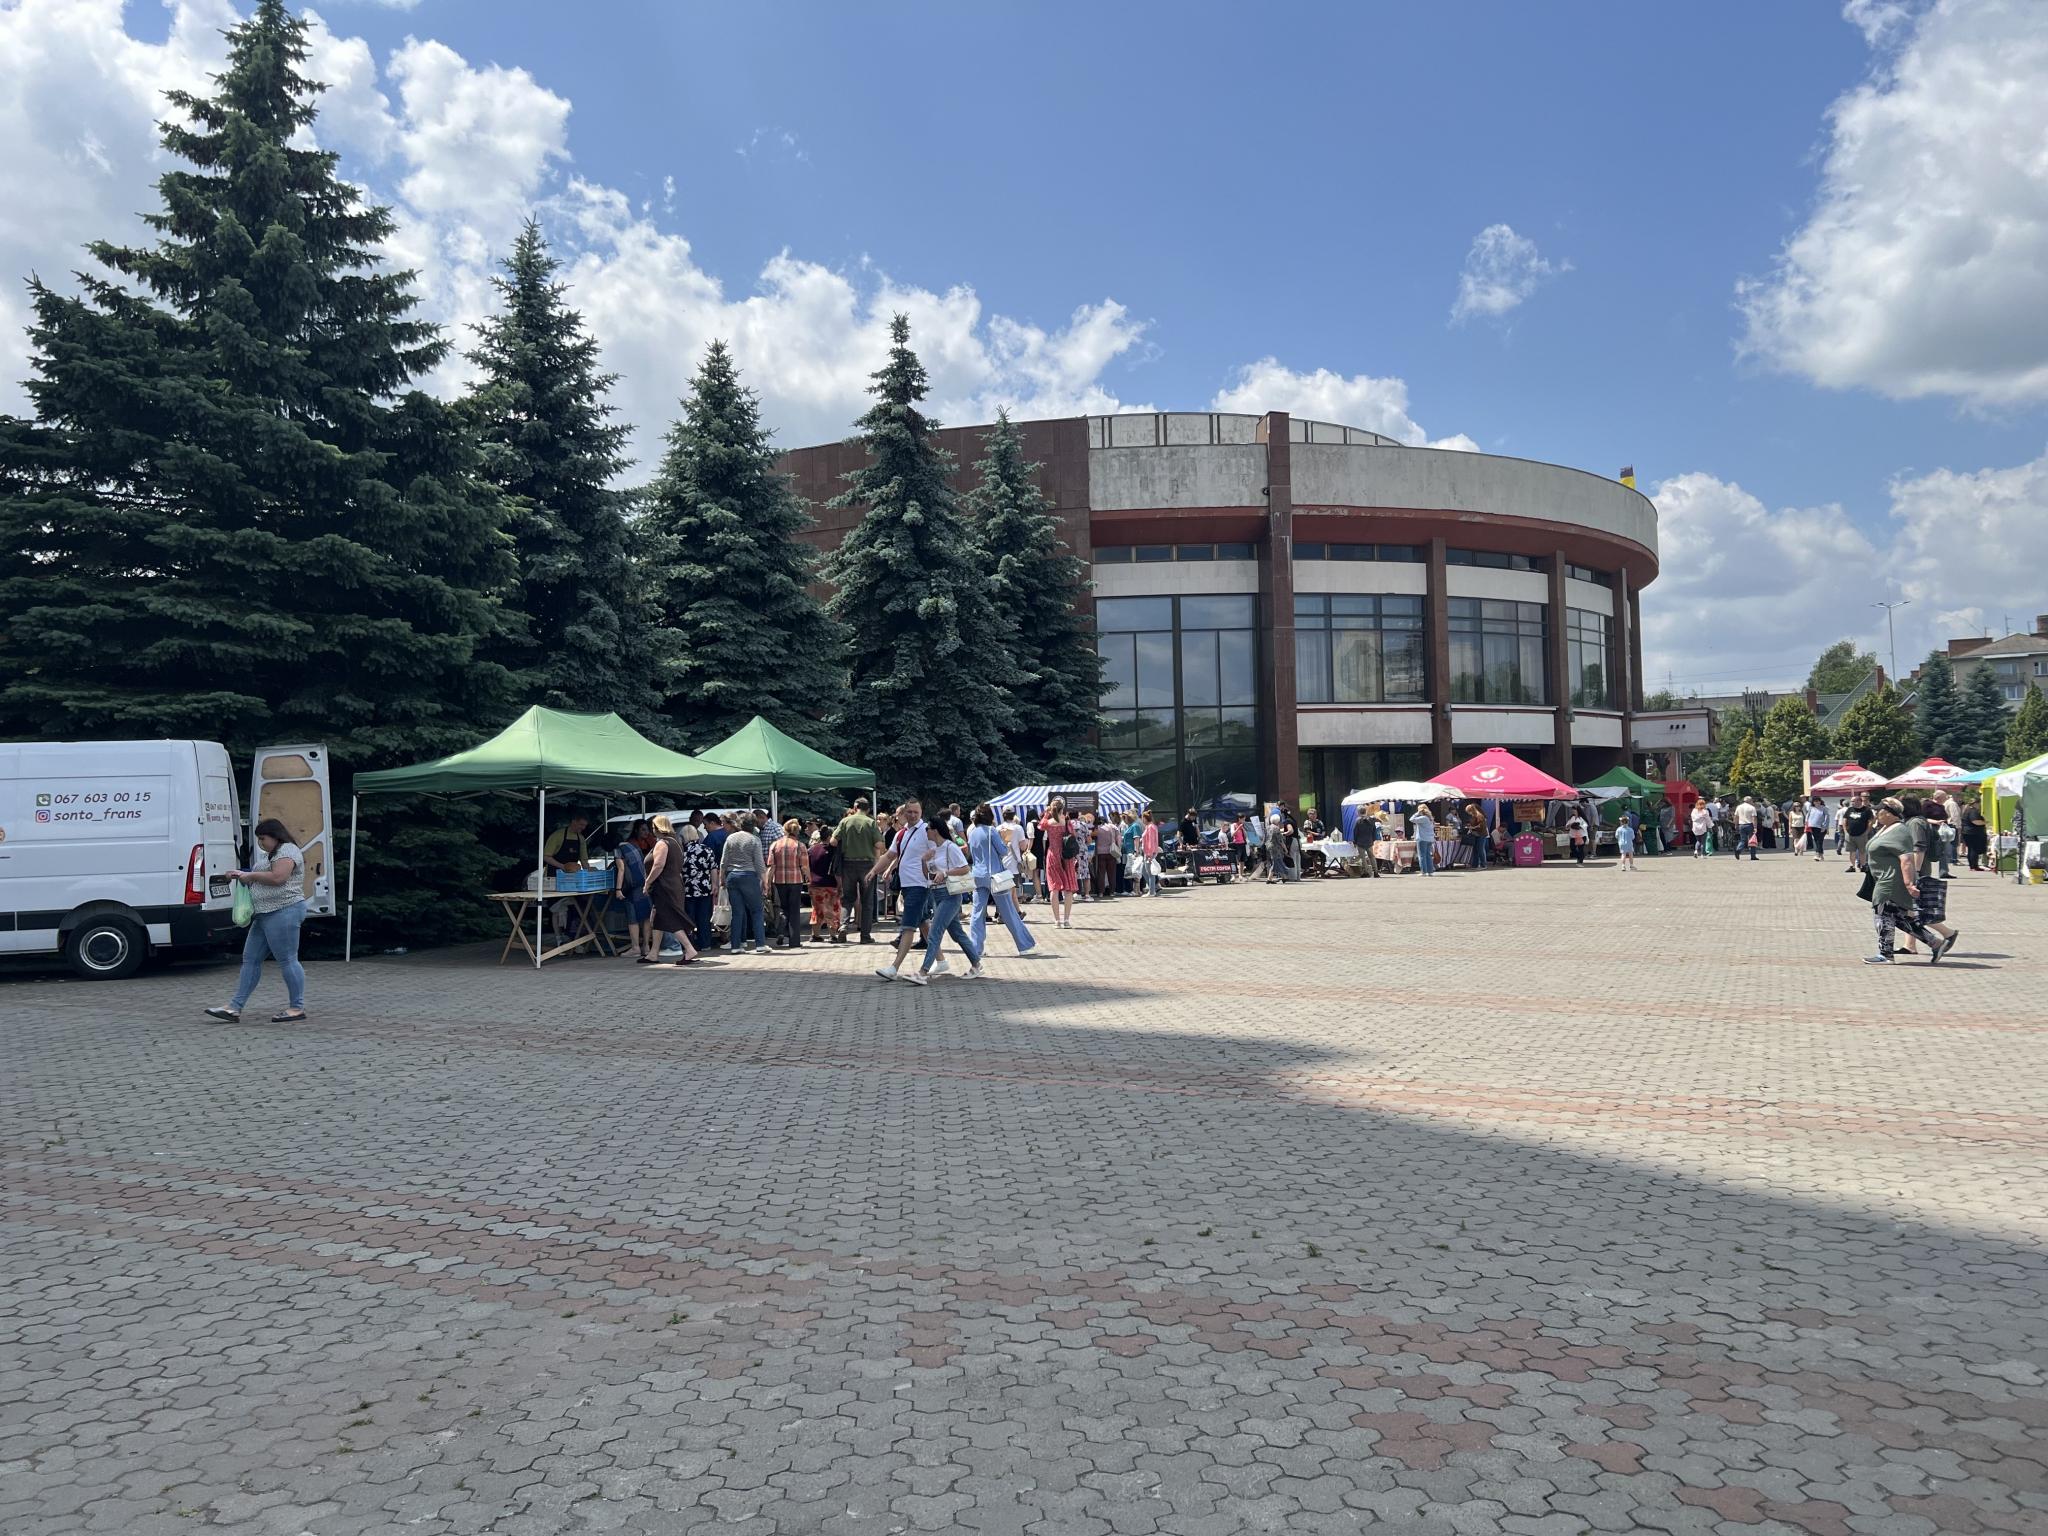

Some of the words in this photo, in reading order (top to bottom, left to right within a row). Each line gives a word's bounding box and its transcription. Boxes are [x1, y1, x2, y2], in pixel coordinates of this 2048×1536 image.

[54, 794, 79, 804] 067
[84, 793, 108, 803] 603
[113, 792, 130, 802] 00
[134, 791, 151, 802] 15
[53, 807, 142, 822] sonto_frans
